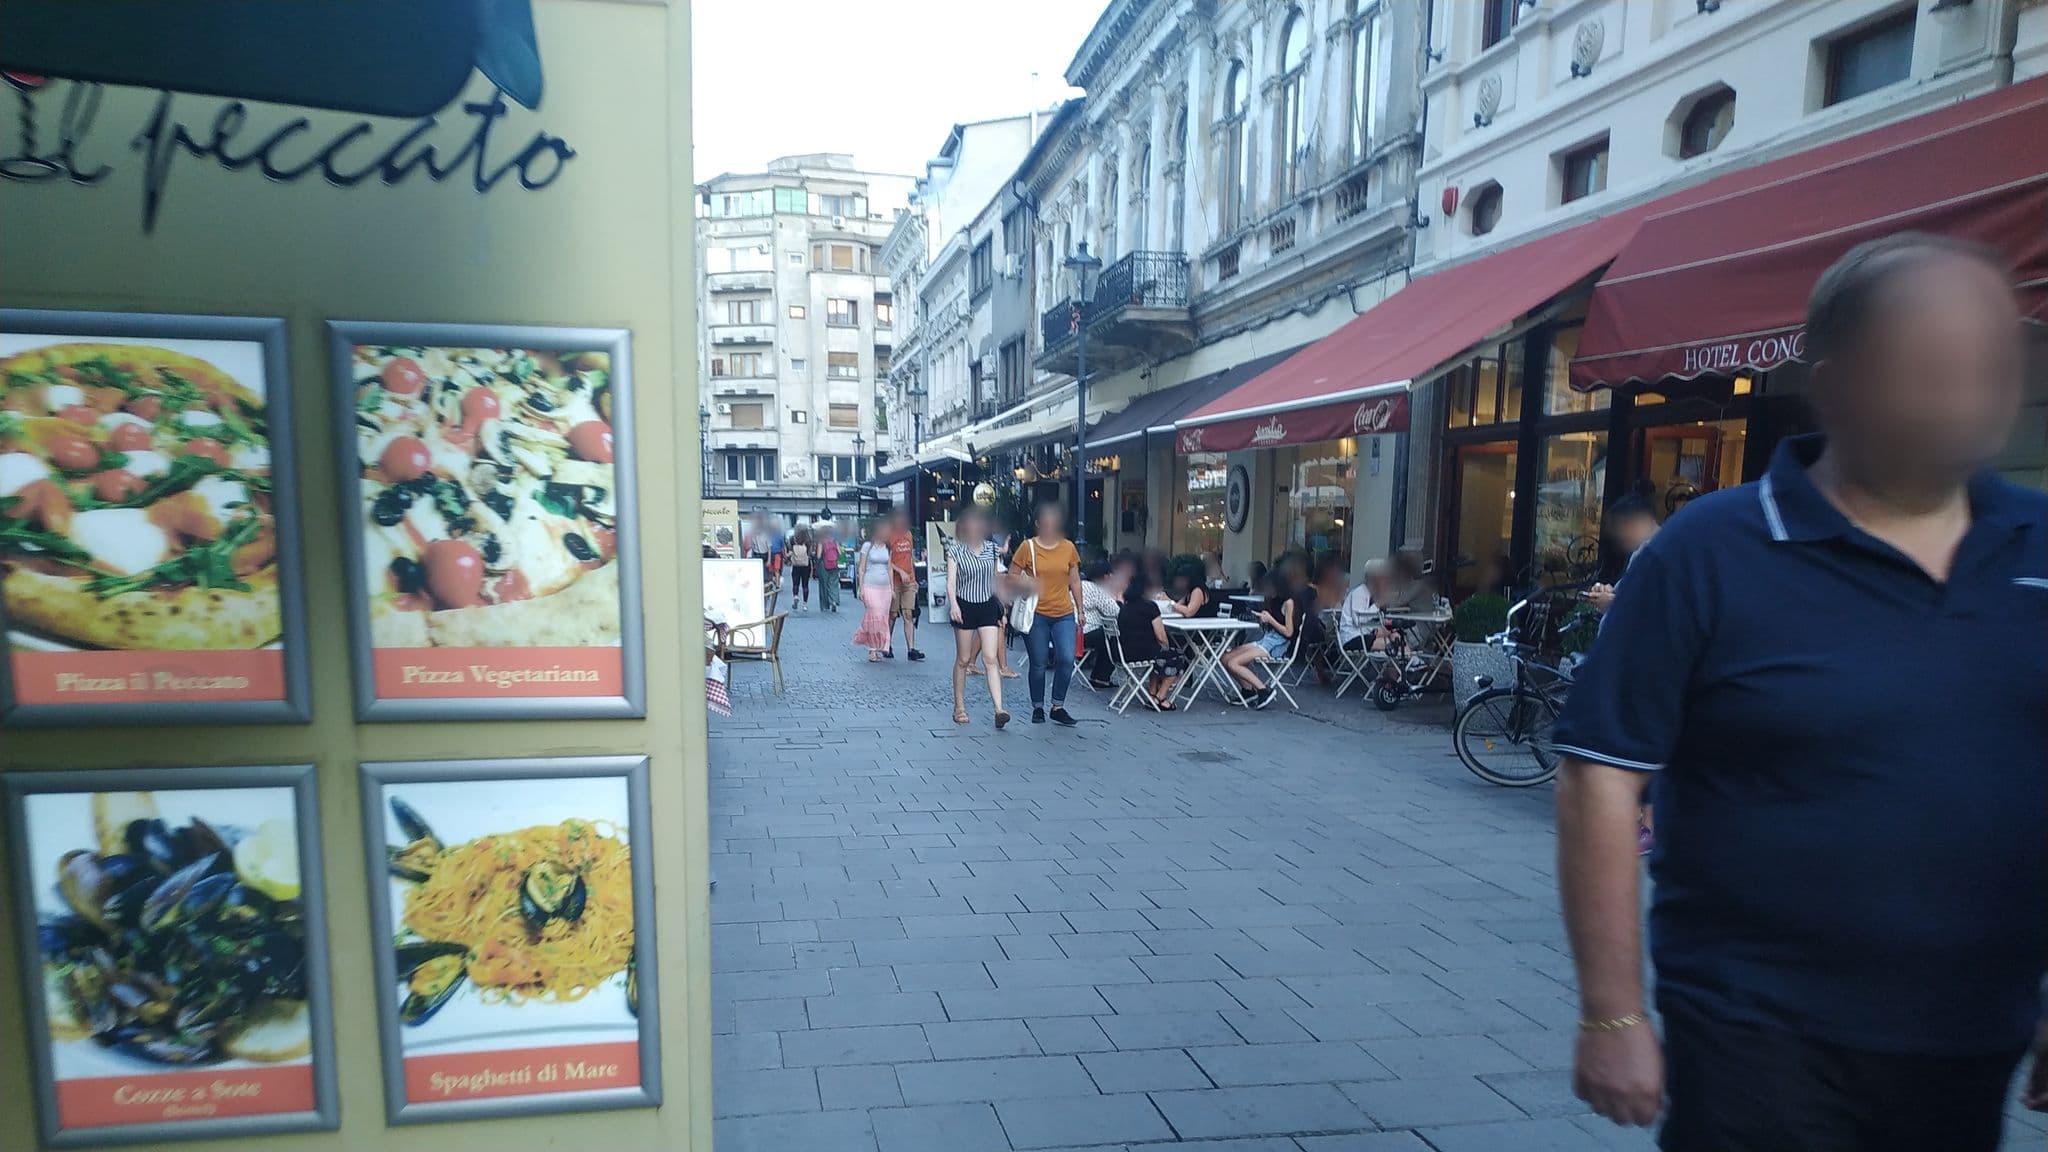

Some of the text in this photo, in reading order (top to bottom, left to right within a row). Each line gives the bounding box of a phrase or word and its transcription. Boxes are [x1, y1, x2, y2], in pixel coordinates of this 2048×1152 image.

[131, 87, 575, 234] peccato
[1684, 344, 1741, 371] HOTEL
[56, 673, 127, 691] Pizza
[153, 671, 249, 689] Peccato
[402, 665, 600, 688] Pizza Vegetariana
[430, 1061, 619, 1095] Spaghetti di Mare
